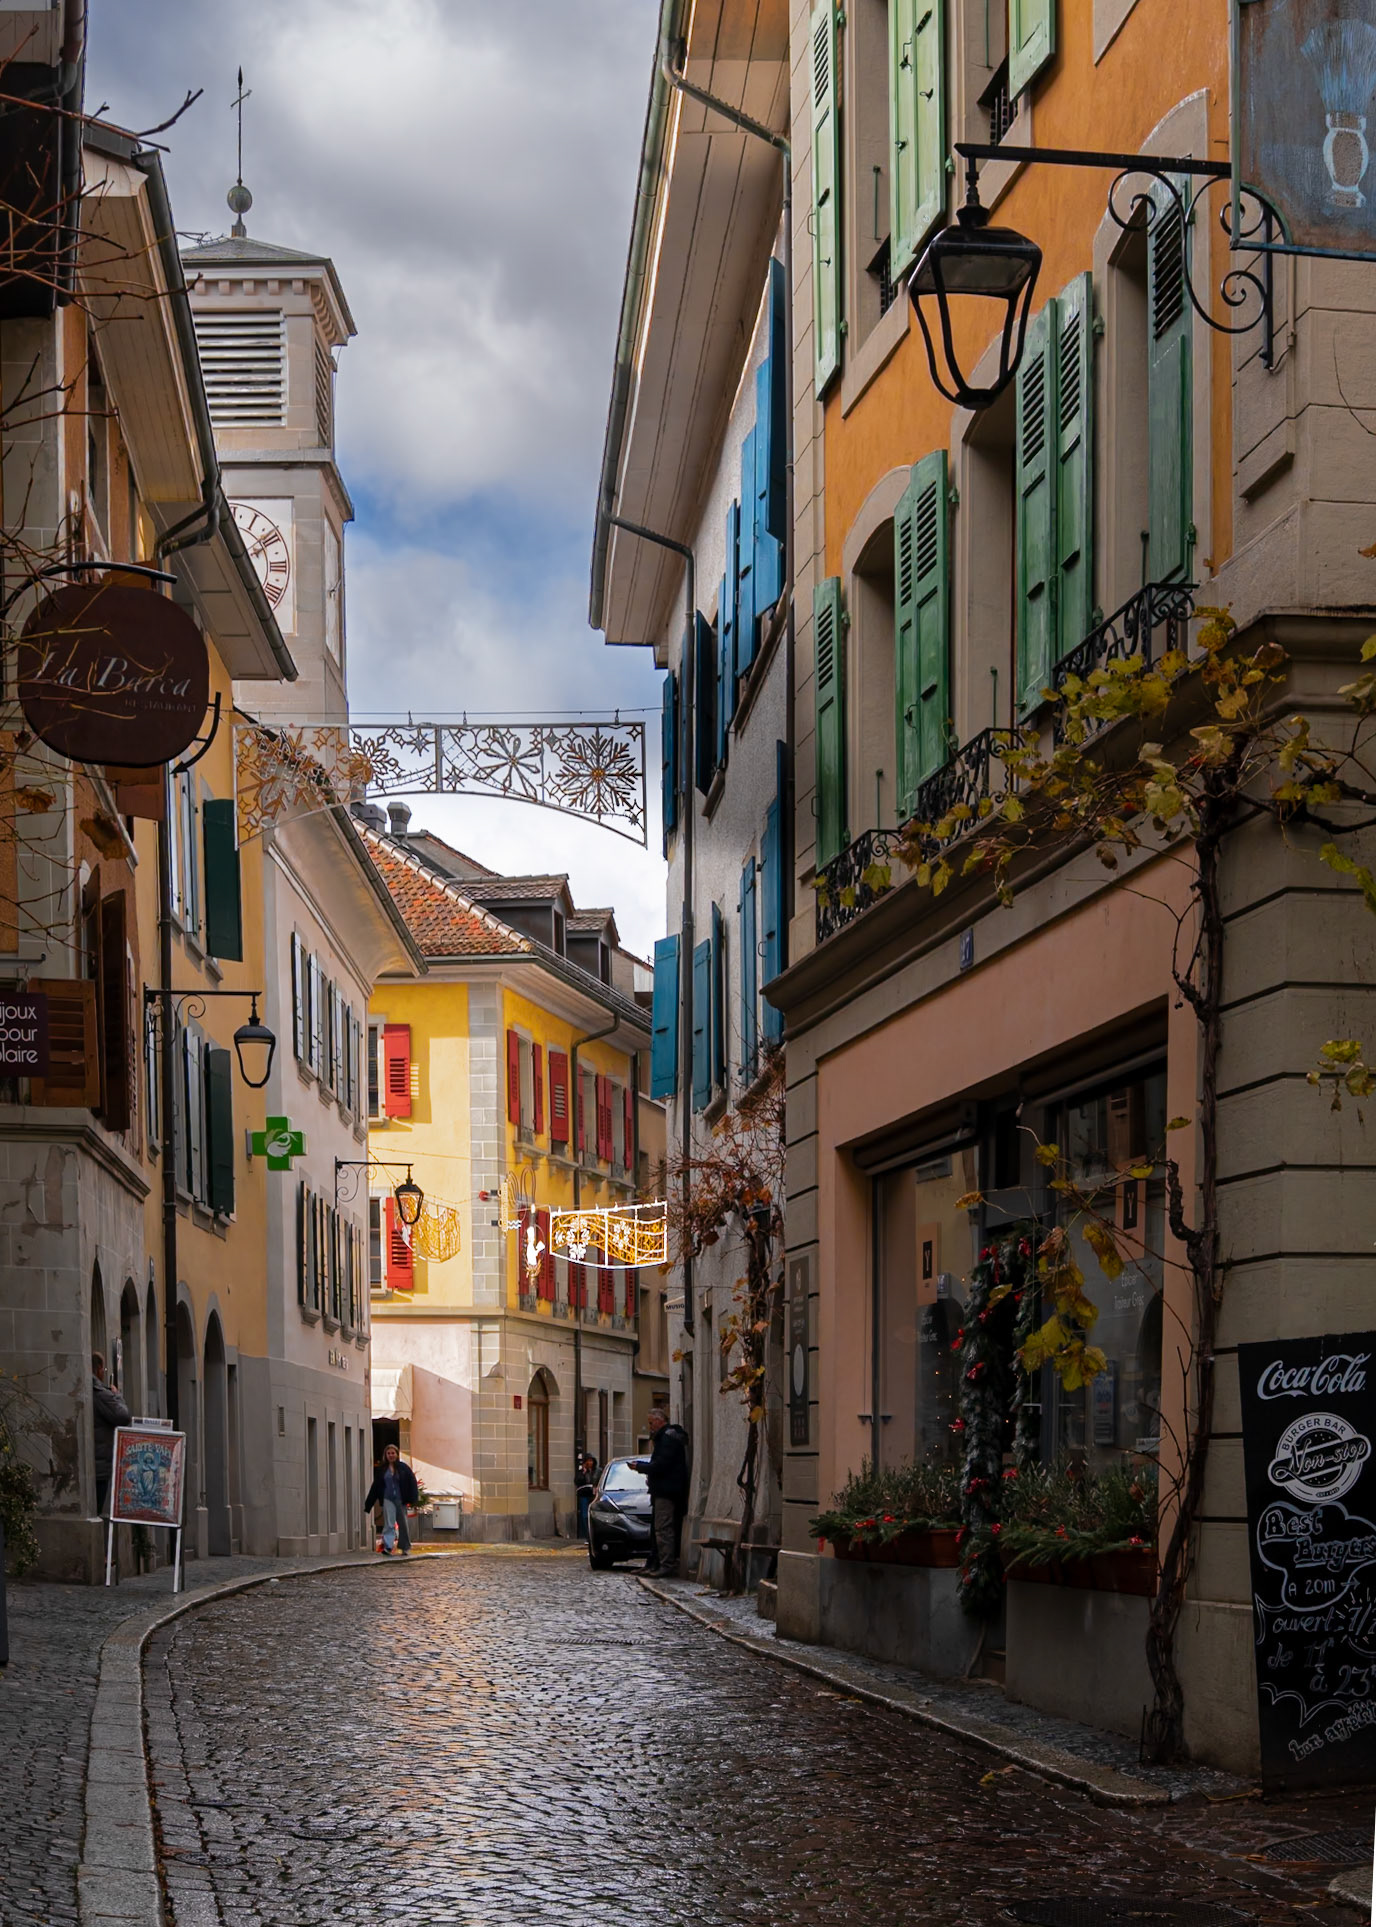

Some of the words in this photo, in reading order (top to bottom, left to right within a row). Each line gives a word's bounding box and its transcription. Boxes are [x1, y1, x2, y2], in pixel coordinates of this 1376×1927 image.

[33, 651, 81, 687] La
[97, 656, 192, 697] Barca
[0, 1042, 38, 1064] laire
[1257, 1353, 1372, 1400] Coca-Cola
[1281, 1418, 1321, 1451] BURGER
[1324, 1418, 1346, 1434] BAR
[1289, 1438, 1366, 1475] Non-stop
[1264, 1509, 1323, 1539] Best
[1288, 1582, 1297, 1597] A
[1267, 1642, 1294, 1669] de
[1288, 1734, 1325, 1761] bon
